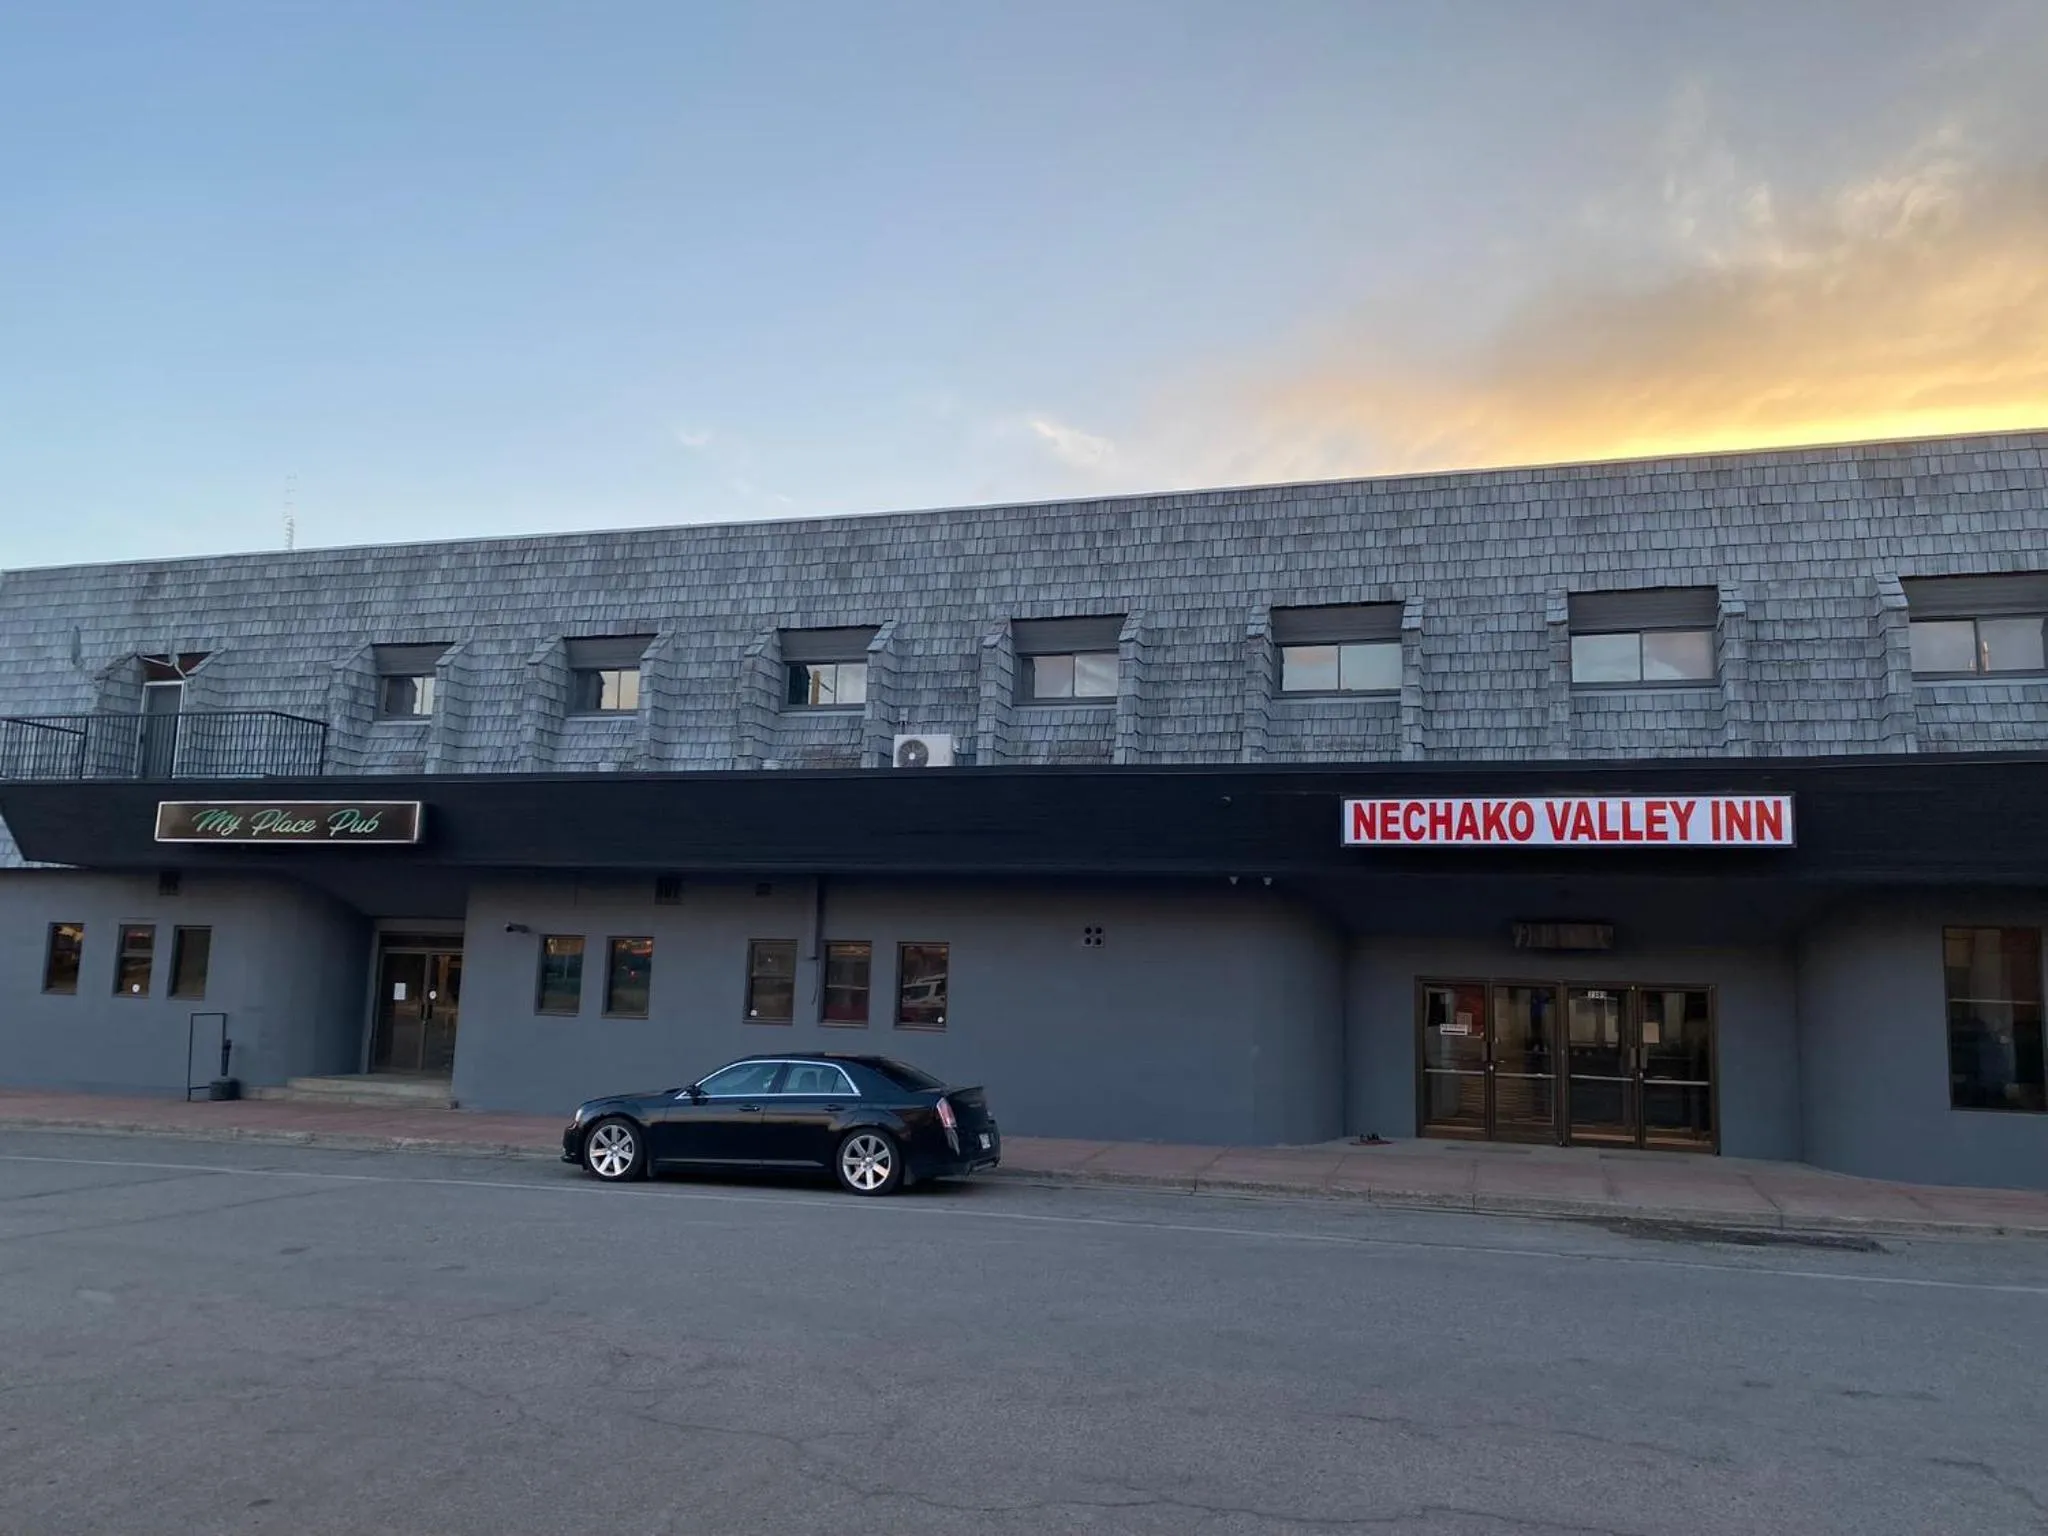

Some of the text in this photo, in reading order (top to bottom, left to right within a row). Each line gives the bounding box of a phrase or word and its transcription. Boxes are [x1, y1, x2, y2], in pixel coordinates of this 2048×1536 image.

[192, 808, 382, 837] My Place Pub
[1353, 800, 1783, 841] NECHAKO VALLEY INN
